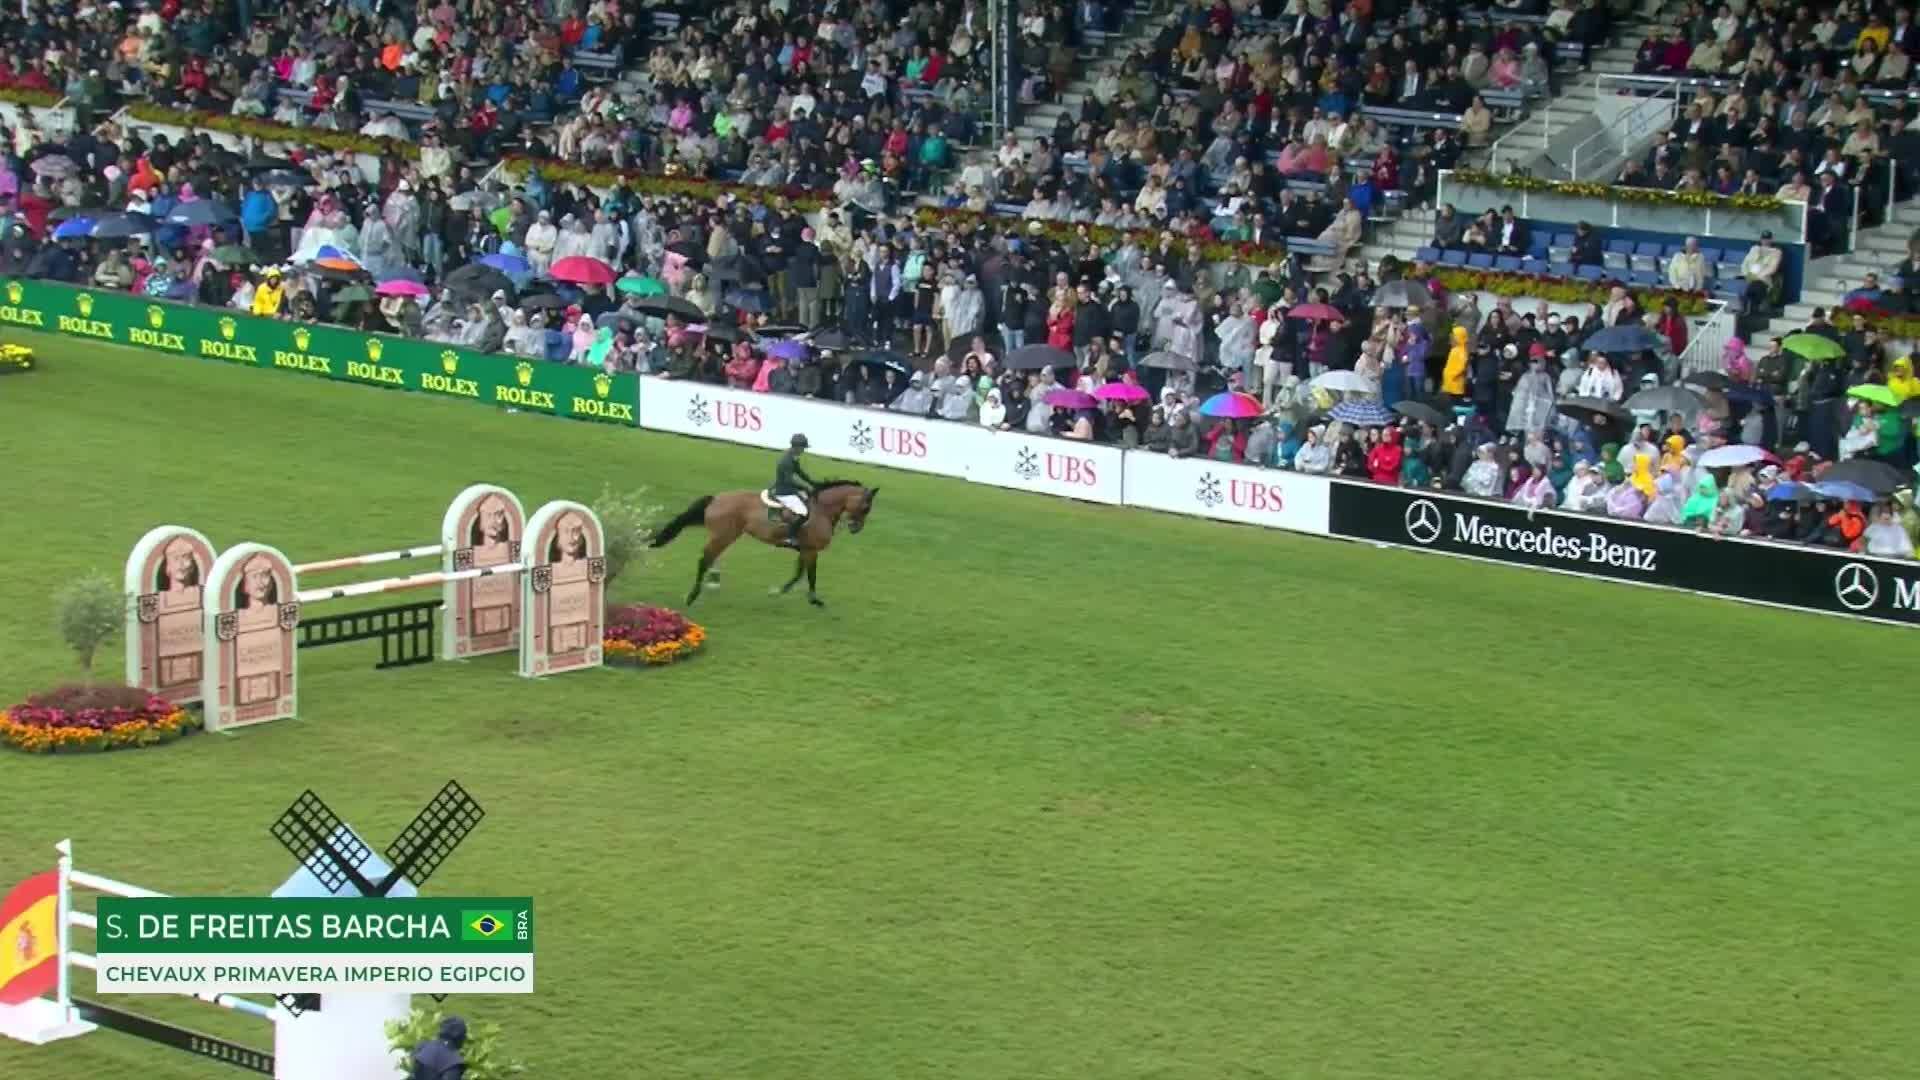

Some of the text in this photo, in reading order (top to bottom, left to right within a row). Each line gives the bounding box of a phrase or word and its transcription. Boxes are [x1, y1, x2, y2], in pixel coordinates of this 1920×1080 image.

[0, 306, 43, 326] OLEX
[58, 315, 113, 338] ROLEX
[128, 326, 185, 351] ROLEX
[201, 338, 257, 362] ROLEX
[275, 351, 330, 374] ROLEX
[347, 361, 404, 385] ROLEX
[421, 372, 479, 397] ROLEX
[496, 384, 555, 409] ROLEX
[573, 396, 634, 421] ROLEX
[716, 401, 762, 431] UBS
[880, 426, 928, 458] UBS
[1044, 453, 1098, 486] UBS
[1229, 479, 1285, 512] UBS
[1453, 512, 1657, 571] Mercedes-Benz
